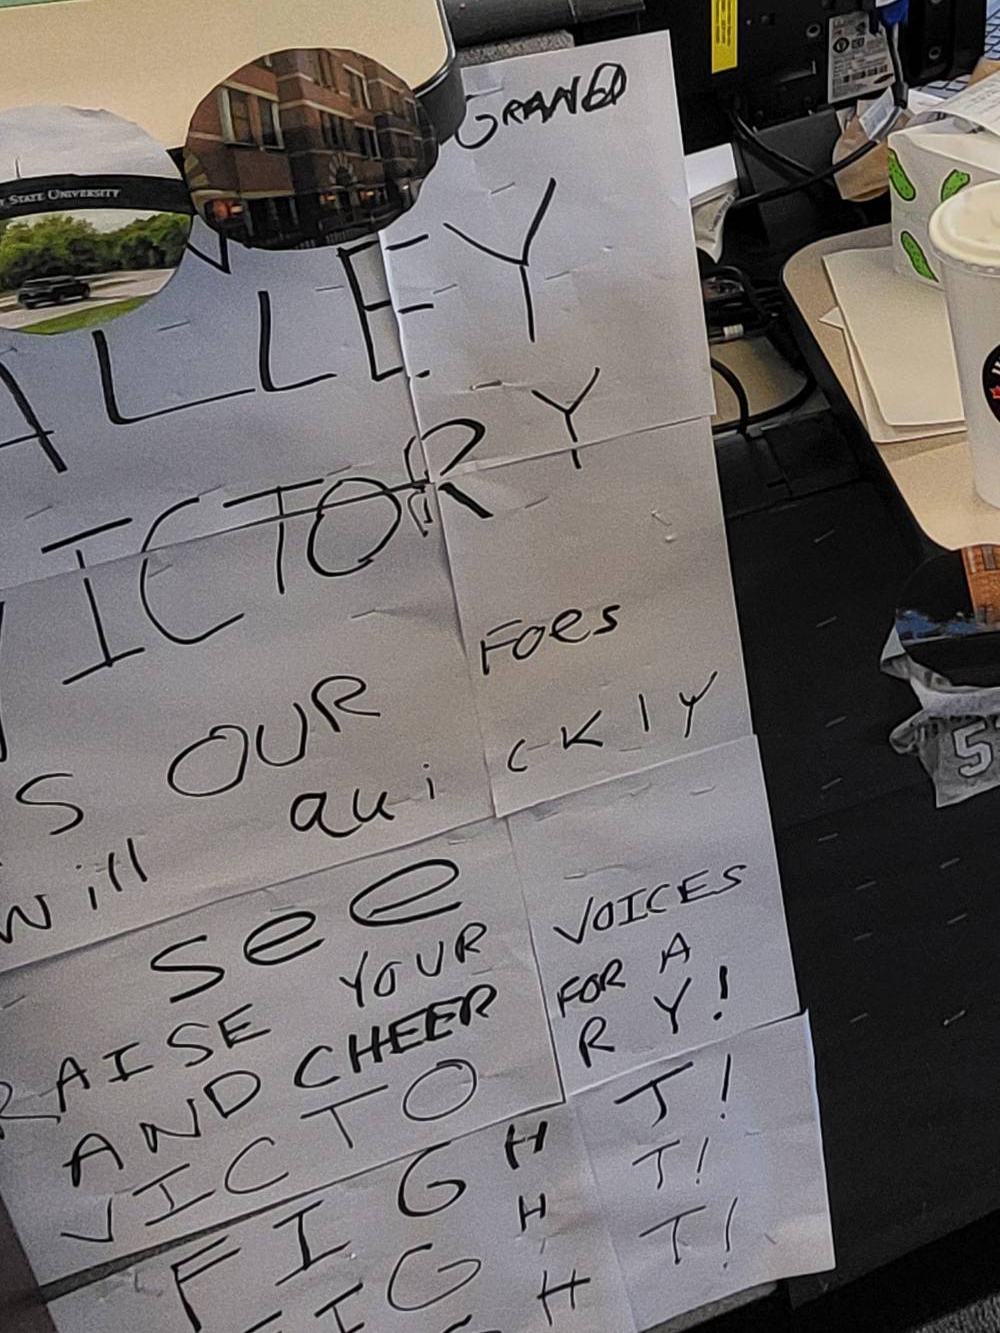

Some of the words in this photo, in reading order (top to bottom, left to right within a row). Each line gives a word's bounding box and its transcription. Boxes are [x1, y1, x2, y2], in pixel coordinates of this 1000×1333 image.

[47, 188, 122, 201] UNIVERSITY
[166, 673, 381, 798] OUR
[339, 922, 487, 1008] YOUR
[553, 864, 747, 945] VOICES
[62, 1070, 262, 1188] AND
[294, 983, 498, 1089] CHEER
[557, 958, 626, 1019] FOR
[659, 931, 692, 975] A
